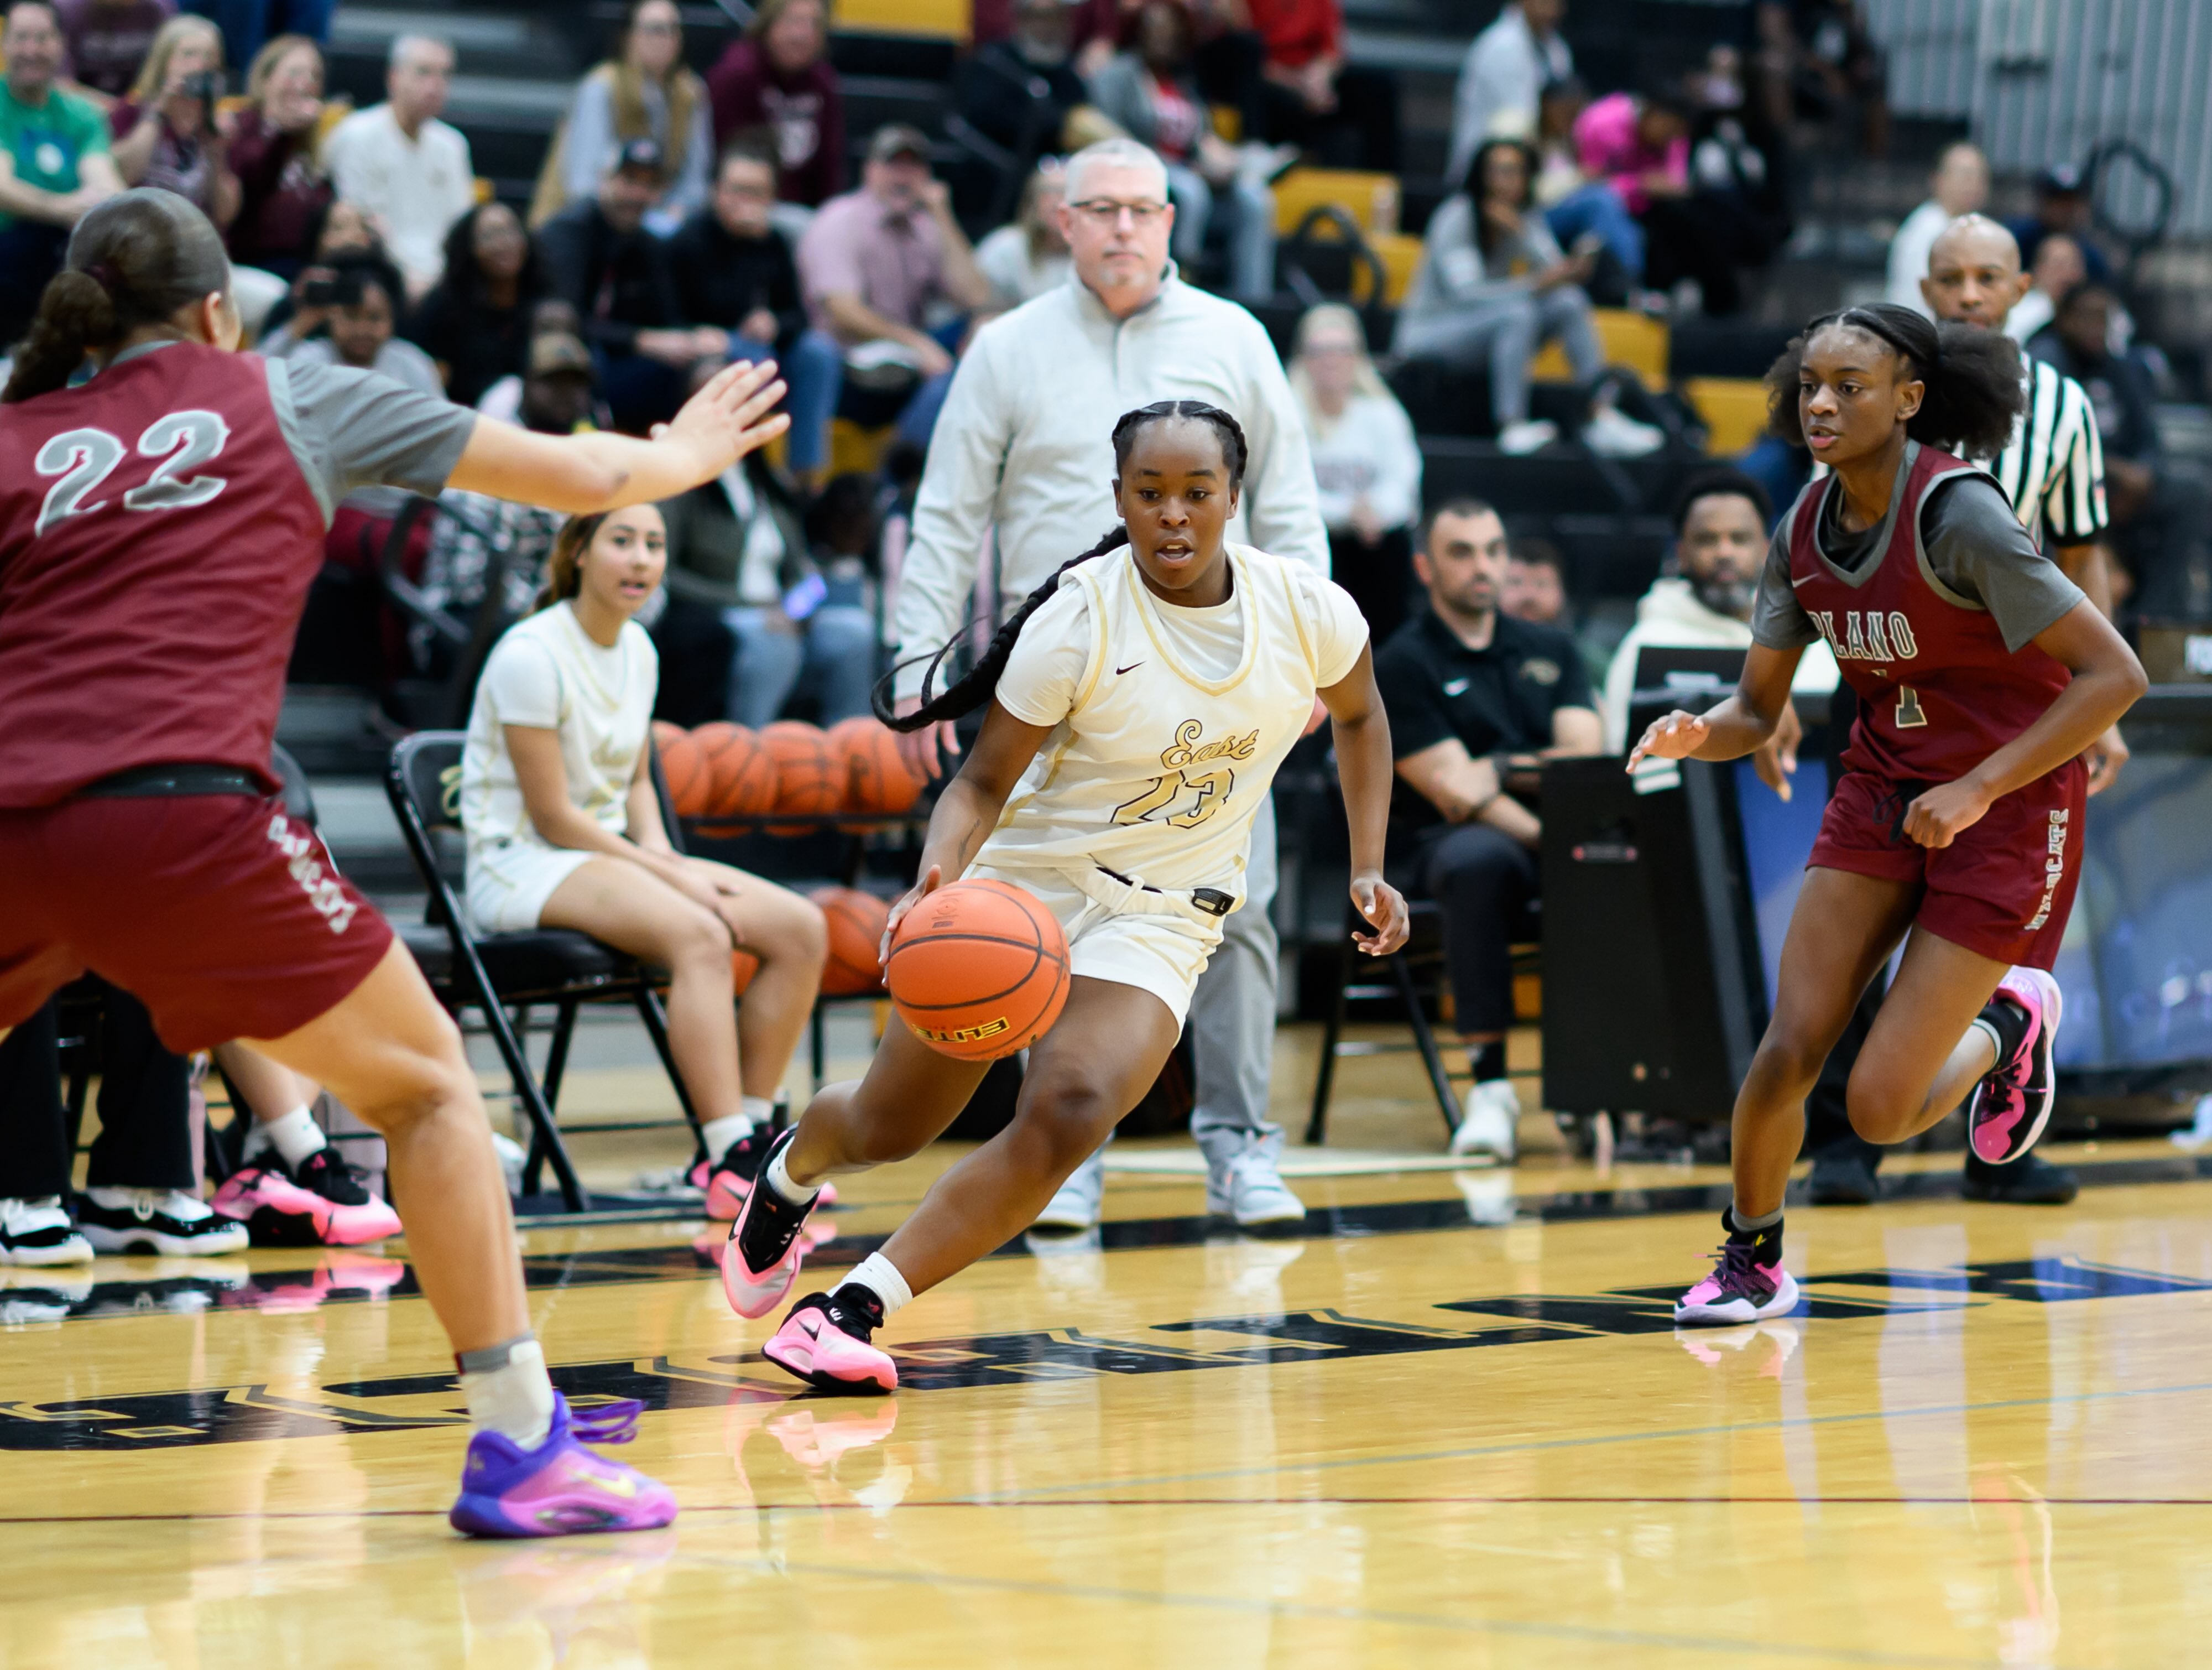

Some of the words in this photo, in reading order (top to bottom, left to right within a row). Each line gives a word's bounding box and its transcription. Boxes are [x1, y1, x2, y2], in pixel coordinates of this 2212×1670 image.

[35, 409, 230, 538] 22
[1871, 669, 1928, 729] 1
[1161, 719, 1260, 769] East
[912, 1016, 1010, 1043] ELITE
